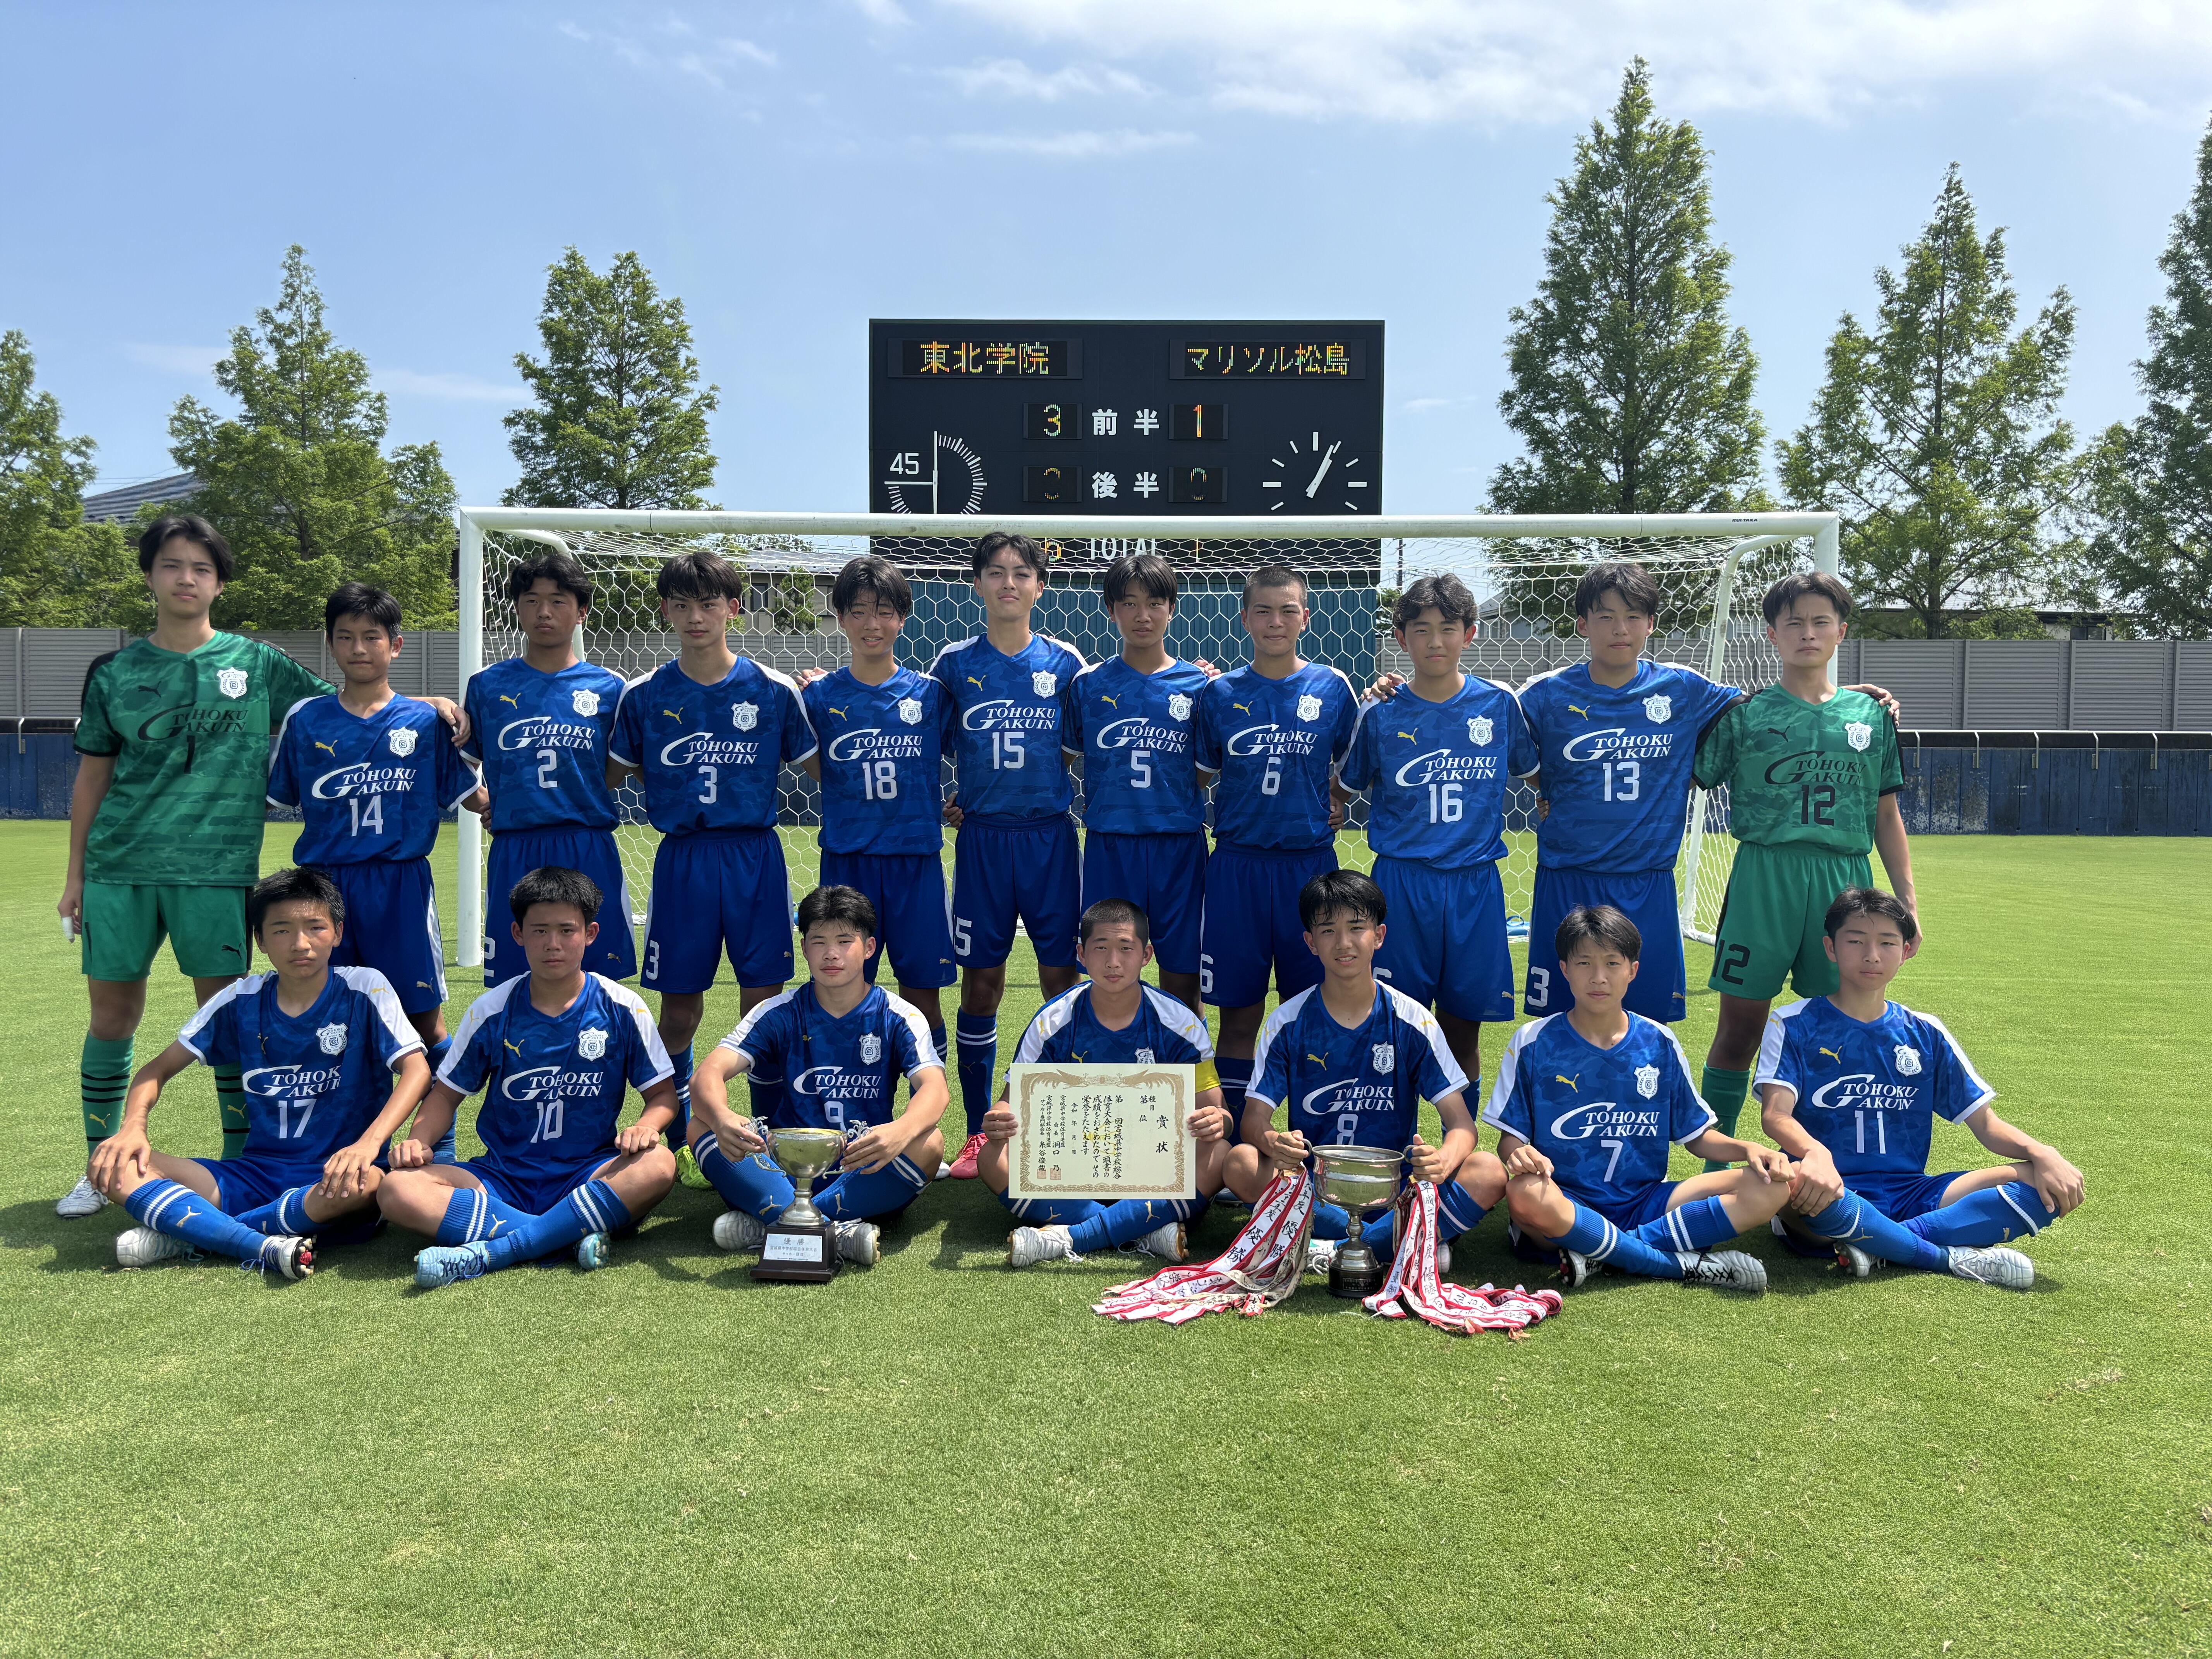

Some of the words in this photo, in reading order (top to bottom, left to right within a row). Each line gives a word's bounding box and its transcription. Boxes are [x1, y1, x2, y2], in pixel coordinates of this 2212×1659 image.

[921, 341, 1048, 374] 東北学院
[1187, 342, 1349, 375] マリソル松島
[1044, 404, 1060, 437] 3
[1092, 409, 1159, 435] 前半
[1193, 405, 1202, 437] 1
[890, 453, 919, 475] 45
[1092, 472, 1159, 498] 後半
[137, 701, 247, 741] GAKUIN
[962, 700, 1055, 731] GAKUIN
[986, 707, 1056, 718] TOHOKU
[498, 716, 592, 750] GAKUIN
[522, 724, 595, 738] TOHOKU
[689, 740, 759, 753] TOHOKU
[828, 728, 922, 761] GAKUIN
[853, 735, 923, 748] TOHOKU
[1097, 718, 1186, 754] GAKUIN
[1121, 725, 1188, 742] TOHOKU
[1255, 730, 1318, 743] TOHOKU
[1563, 728, 1672, 761] GAKUIN
[1595, 734, 1673, 749] TOHOKU
[183, 735, 196, 774] 1
[661, 732, 757, 766] GAKUIN
[992, 732, 1025, 769] 15
[1425, 756, 1498, 771] TOHOKU
[1795, 759, 1867, 773] TOHOKU
[312, 762, 414, 799] GAKUIN
[343, 768, 417, 786] TOHOKU
[536, 749, 558, 788] 2
[698, 766, 718, 804] 3
[862, 761, 898, 800] 18
[1130, 750, 1151, 788] 5
[1261, 757, 1281, 795] 6
[1395, 749, 1497, 787] GAKUIN
[1602, 761, 1640, 802] 13
[349, 794, 384, 836] 14
[1429, 783, 1463, 823] 16
[1801, 784, 1836, 826] 12
[954, 914, 972, 956] 5
[645, 940, 659, 980] 3
[1200, 953, 1214, 993] 6
[1712, 939, 1750, 986] 12
[272, 1065, 342, 1085] TOHOK
[501, 1066, 601, 1101] GAKUIN
[529, 1072, 603, 1088] TOHOKU
[793, 1066, 879, 1099] GAKUIN
[814, 1074, 882, 1087] TOHOKU
[1812, 1074, 1915, 1110] GAKUIN
[1843, 1084, 1919, 1098] TOHOKU
[278, 1098, 317, 1139] 17
[530, 1099, 564, 1143] 10
[824, 1101, 847, 1132] 9
[1080, 1095, 1092, 1155] 栄誉をたたえます
[1336, 1114, 1358, 1145] 8
[1551, 1102, 1657, 1140] GAKUIN
[1585, 1111, 1660, 1124] TOHOKU
[1854, 1110, 1886, 1154] 11
[1102, 1095, 1113, 1178] 体育大会において頭書の
[1601, 1139, 1623, 1182] 7
